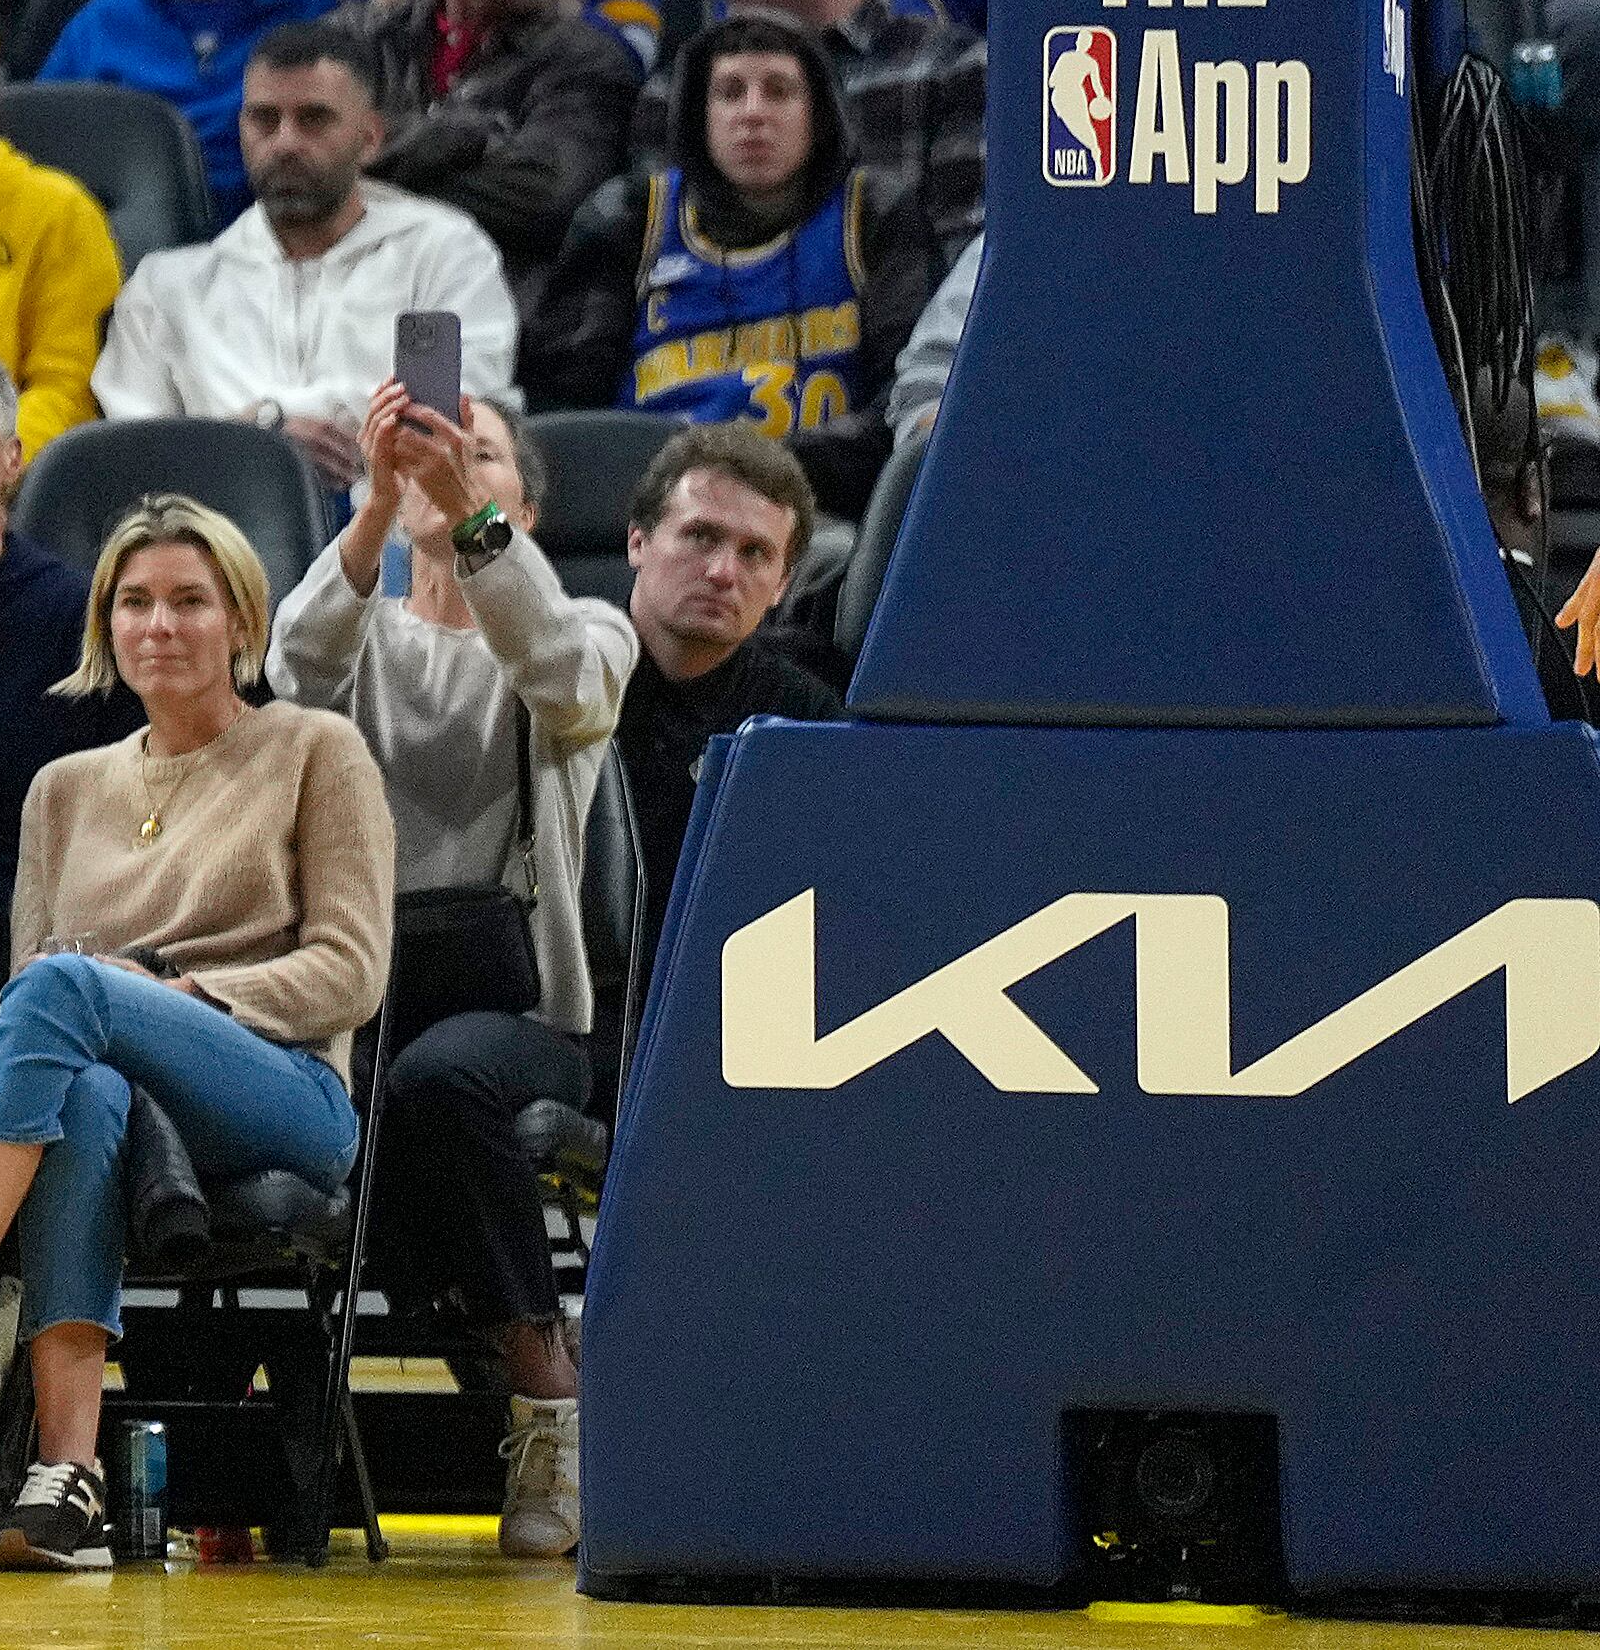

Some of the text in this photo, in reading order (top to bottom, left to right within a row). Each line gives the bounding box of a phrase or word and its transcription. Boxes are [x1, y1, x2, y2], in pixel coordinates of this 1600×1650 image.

[1054, 29, 1312, 215] NBA App
[720, 887, 1600, 1105] KIA
